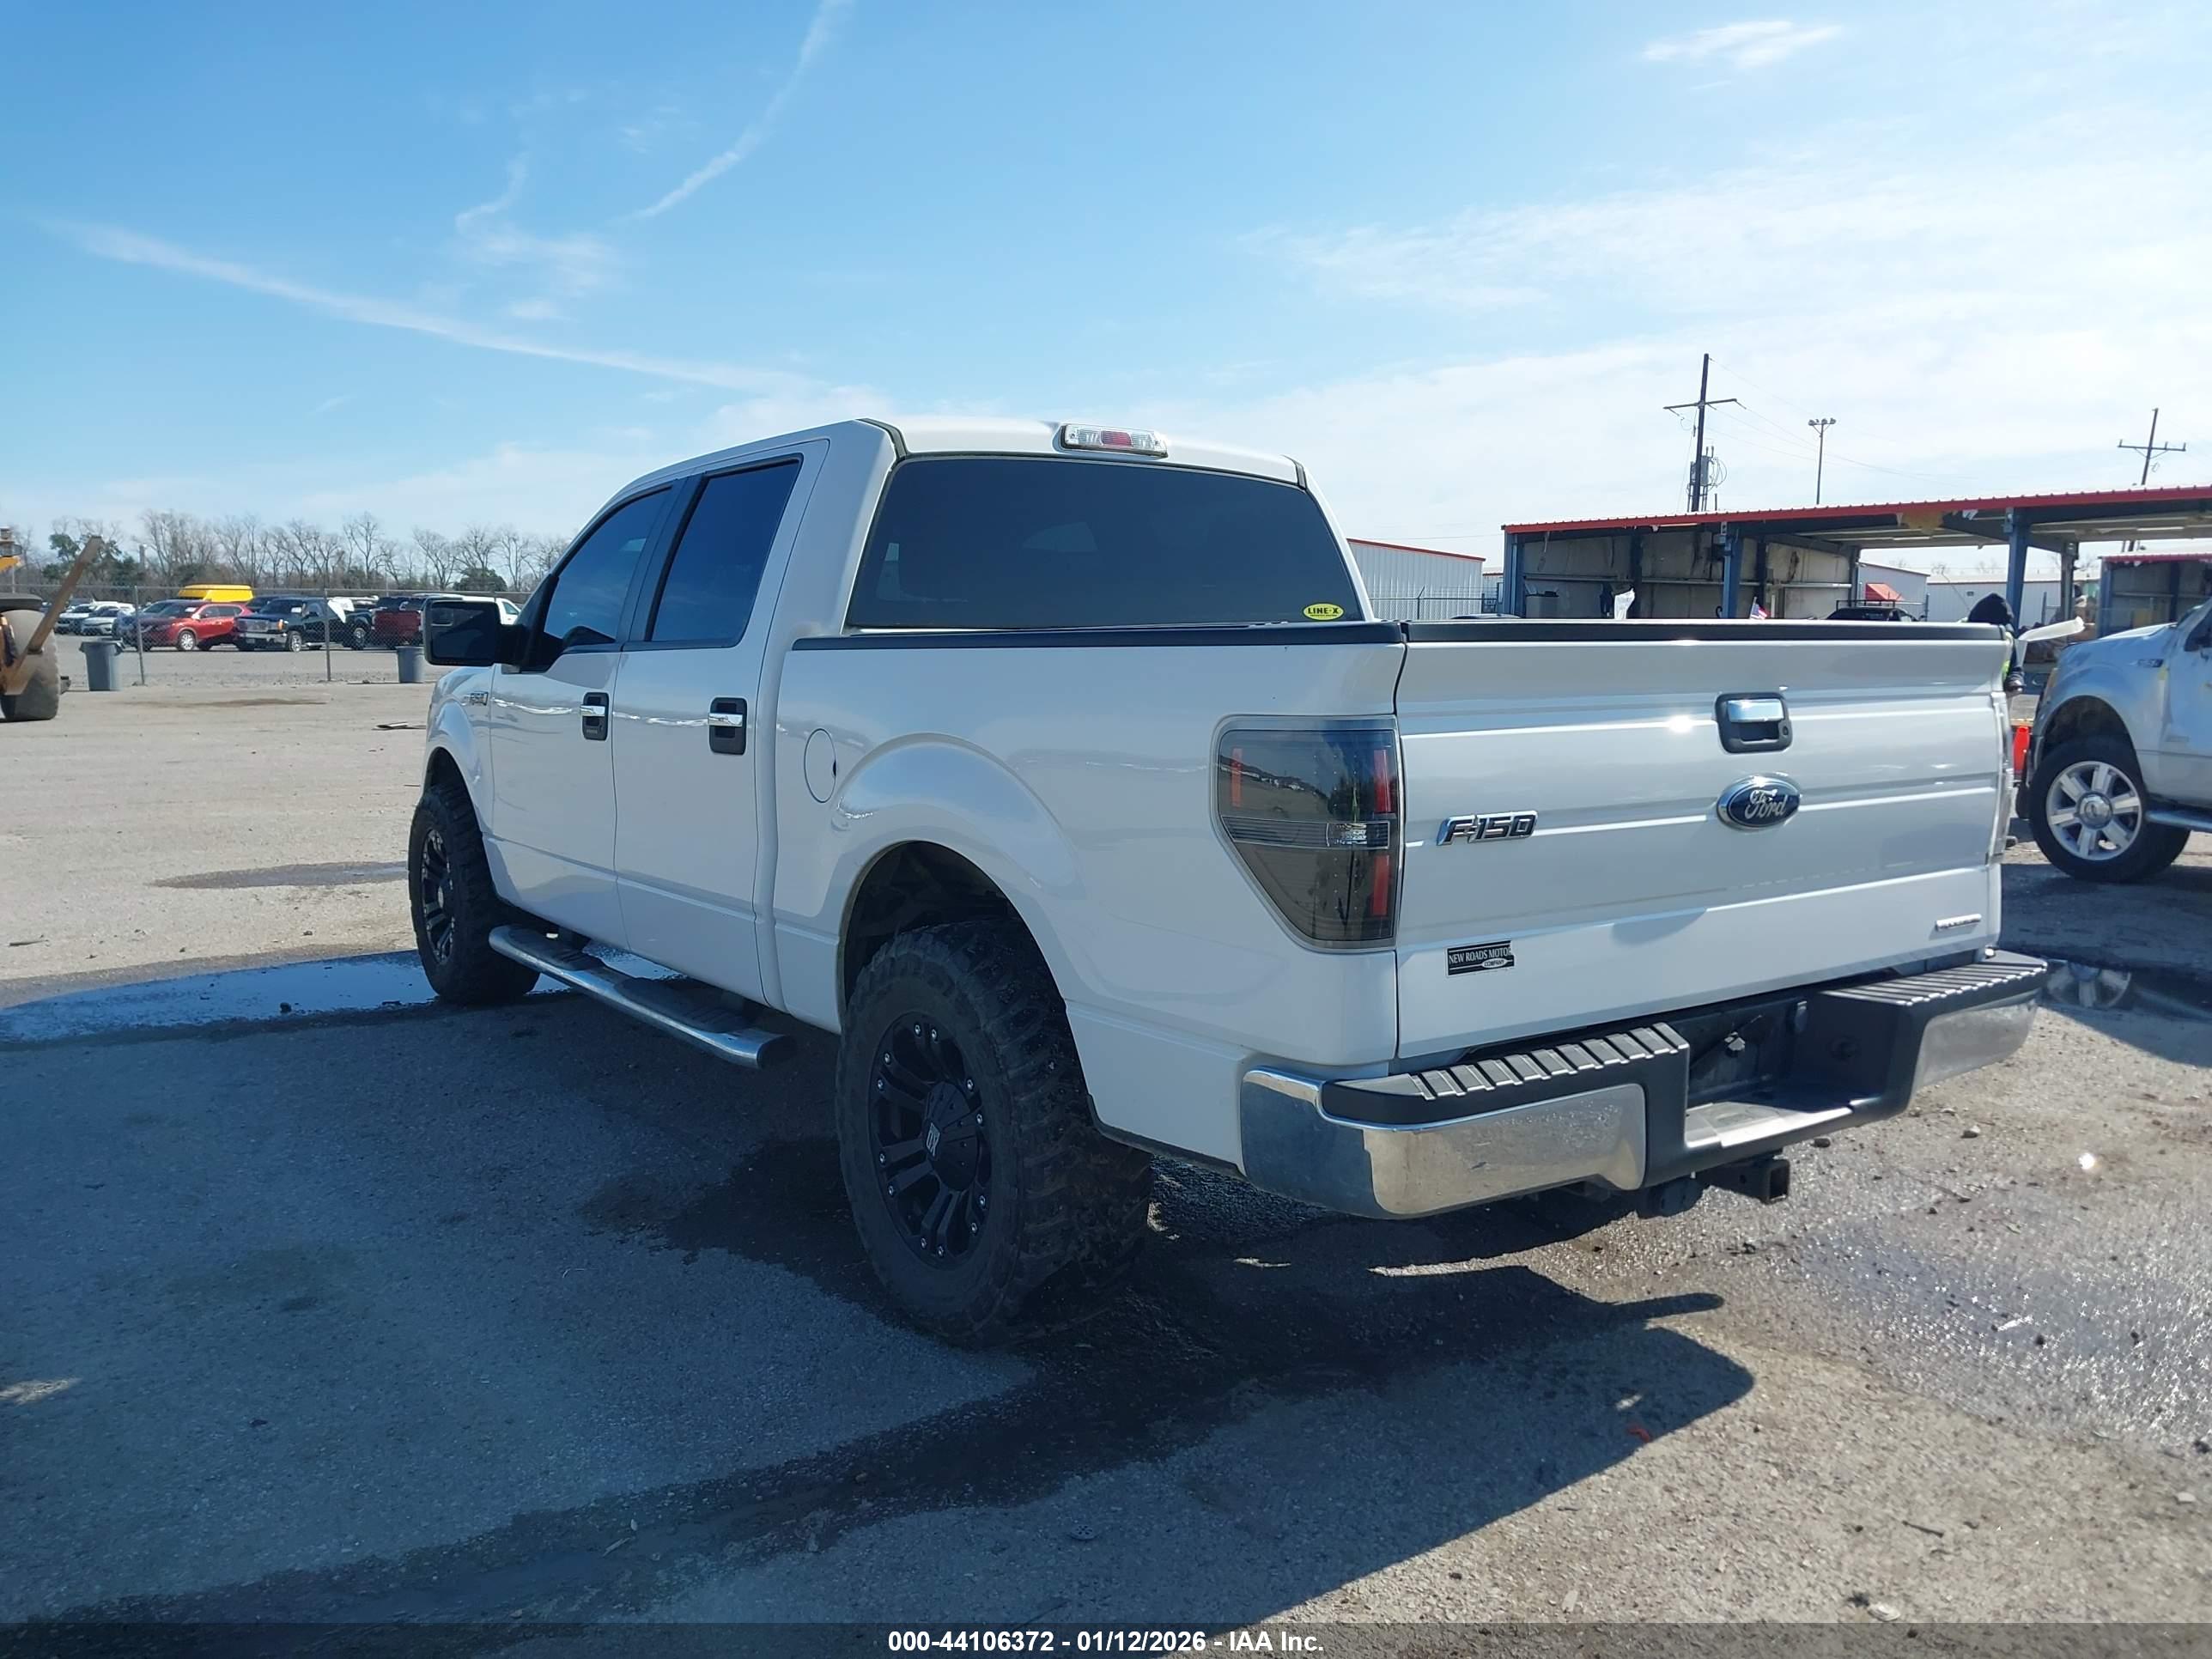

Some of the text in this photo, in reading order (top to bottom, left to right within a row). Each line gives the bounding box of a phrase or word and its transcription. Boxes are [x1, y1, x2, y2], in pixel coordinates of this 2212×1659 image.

[1744, 788, 1788, 819] Ford
[1437, 811, 1538, 846] F-150
[1449, 952, 1465, 965] NEW
[1465, 949, 1487, 963] ROADS
